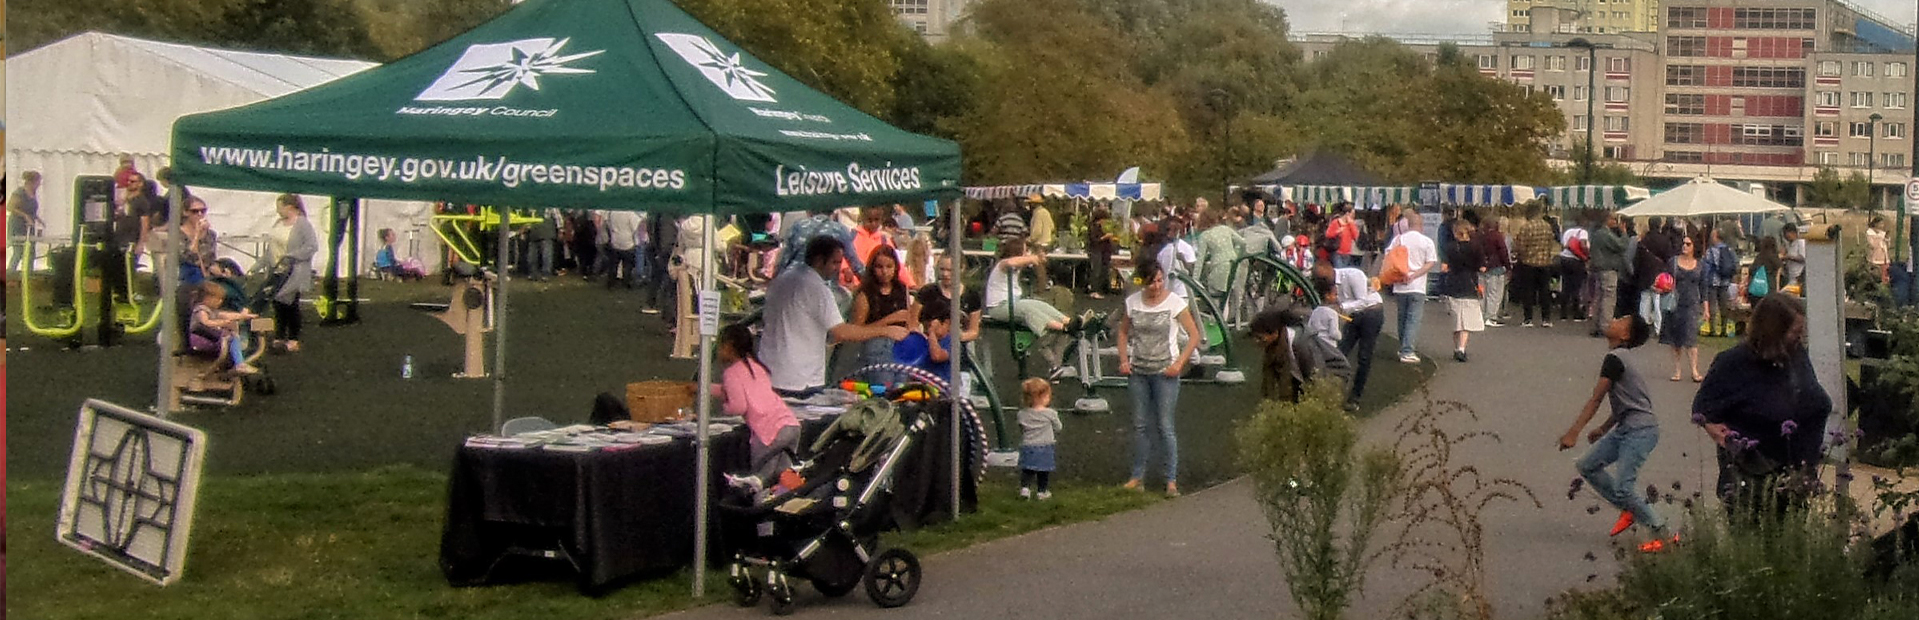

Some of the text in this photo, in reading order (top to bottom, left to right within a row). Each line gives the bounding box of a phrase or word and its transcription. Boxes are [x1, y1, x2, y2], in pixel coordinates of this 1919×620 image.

[490, 106, 559, 117] Council
[200, 144, 685, 192] www.haringey.gov.uk/greenspaces
[775, 160, 921, 196] Leisure Services
